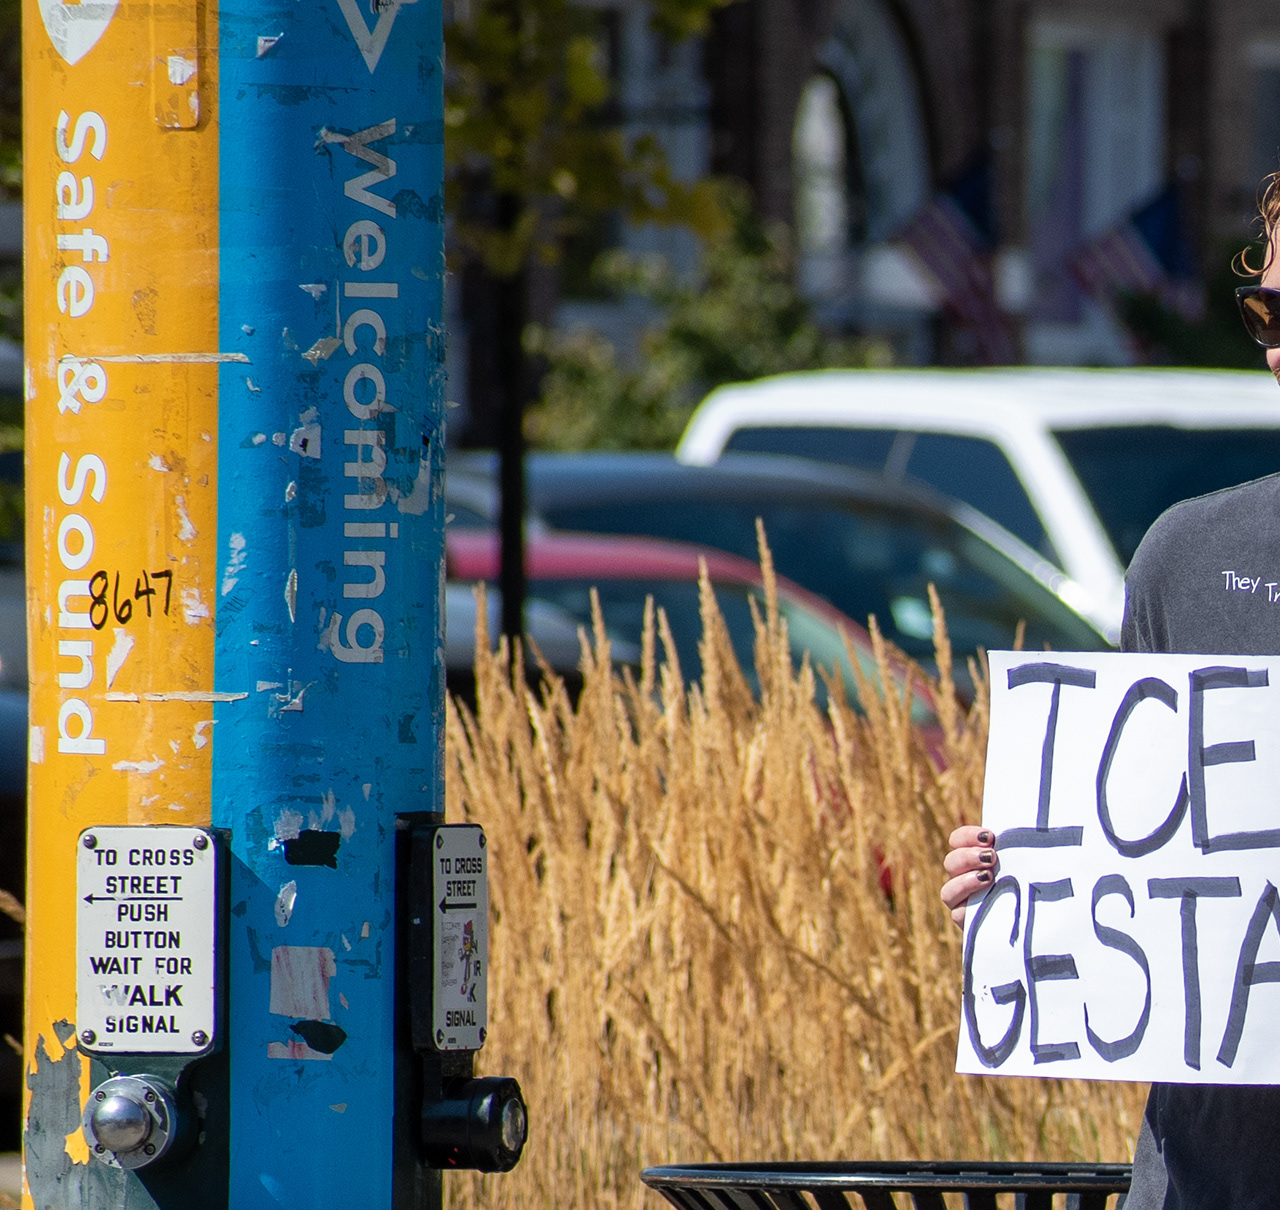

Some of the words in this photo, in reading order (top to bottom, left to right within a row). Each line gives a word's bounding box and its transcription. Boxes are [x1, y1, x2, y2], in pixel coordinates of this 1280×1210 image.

[57, 110, 108, 318] Safe
[57, 353, 107, 415] &
[331, 117, 398, 664] Welcoming
[1222, 571, 1261, 593] They
[57, 452, 107, 755] Sound
[88, 569, 173, 631] 8647
[94, 849, 117, 866] TO
[128, 849, 194, 866] CROSS
[439, 858, 451, 874] TO
[454, 858, 482, 874] CROSS
[106, 876, 182, 894] STREET
[446, 880, 477, 897] STREET
[117, 904, 168, 922] PUSH
[105, 931, 180, 949] BUTTON
[90, 957, 142, 975] WAIT
[155, 957, 192, 975] FOR
[105, 1015, 180, 1034] SIGNAL
[446, 1010, 477, 1027] SIGNAL
